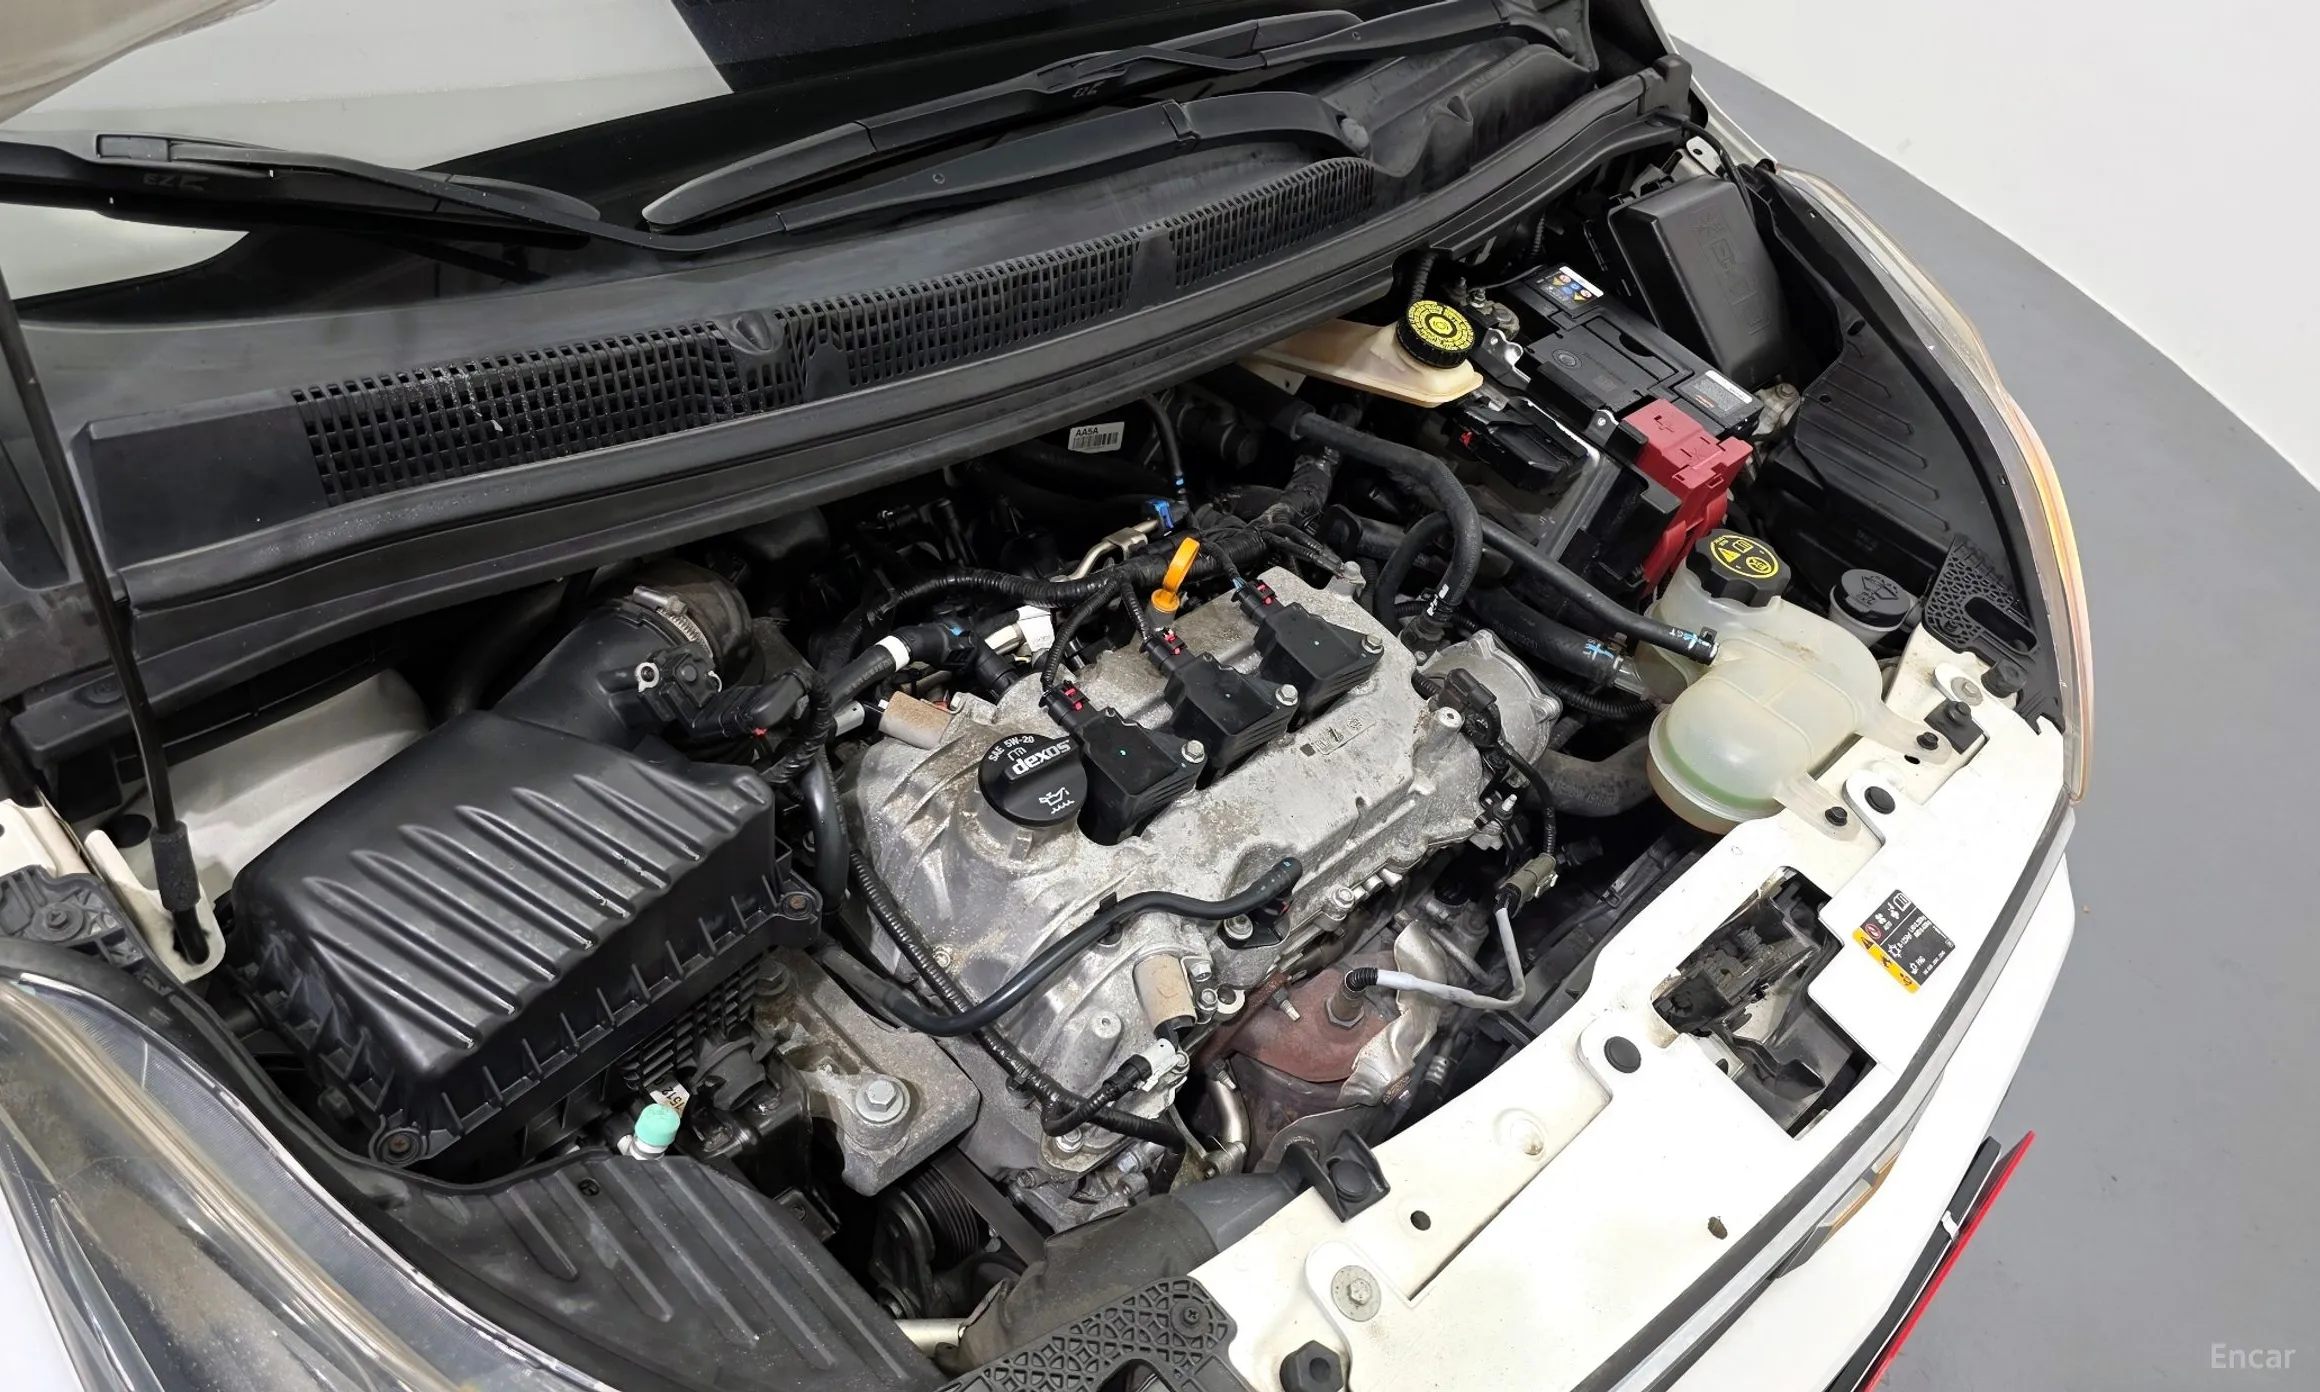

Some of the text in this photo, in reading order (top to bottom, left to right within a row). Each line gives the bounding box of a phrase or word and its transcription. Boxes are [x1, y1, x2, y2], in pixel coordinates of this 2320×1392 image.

[1076, 427, 1098, 437] AA5A
[988, 735, 1035, 762] SAE 5W-20
[1011, 739, 1072, 775] dexos
